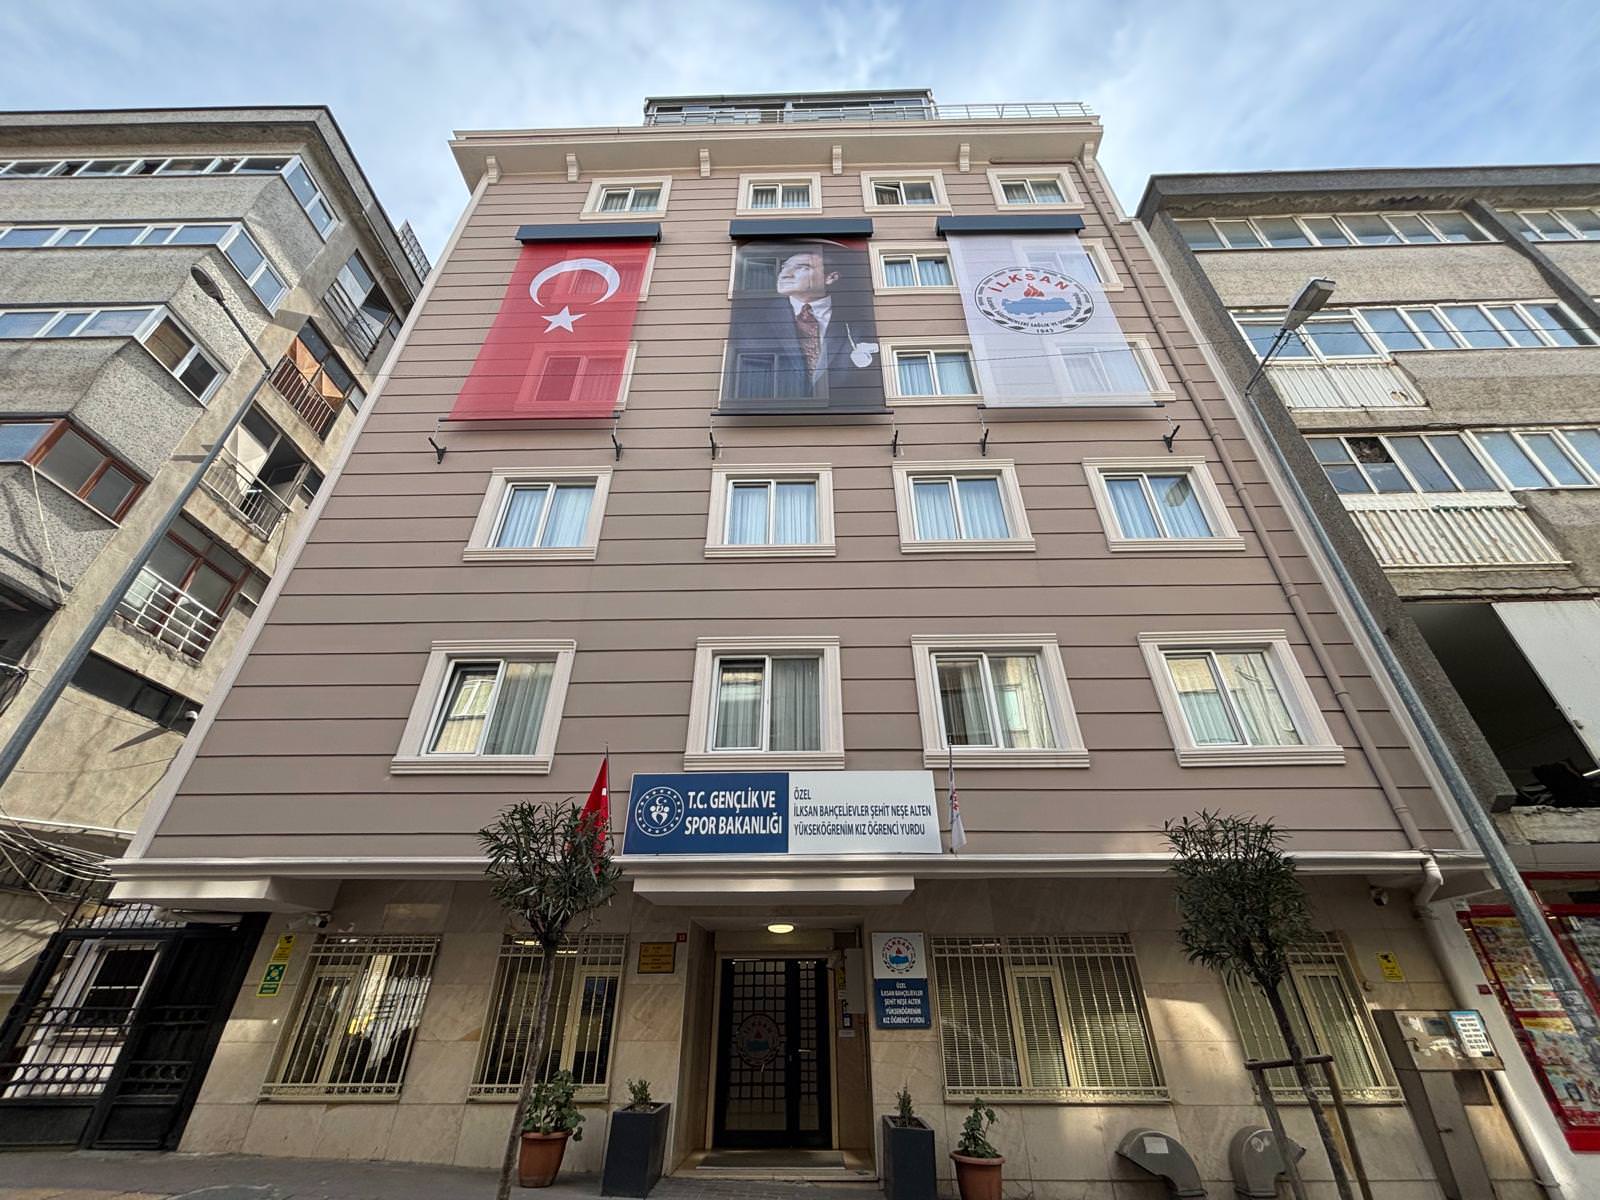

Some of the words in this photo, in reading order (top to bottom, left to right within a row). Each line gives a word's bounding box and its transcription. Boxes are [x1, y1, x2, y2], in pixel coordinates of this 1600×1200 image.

[687, 791, 708, 809] T.C.
[709, 786, 759, 814] GENÇLİK
[760, 790, 776, 808] VE
[793, 786, 811, 800] ÖZEL
[819, 803, 869, 820] BAHÇELİEVLER
[870, 802, 890, 820] ŞEHİT
[891, 804, 909, 820] NEŞE
[910, 804, 932, 817] ALTEN
[684, 816, 716, 835] SPOR
[718, 811, 783, 835] BAKANLIĞI
[794, 820, 854, 836] YÜKSEKÖĞRENİM
[855, 823, 867, 836] KIZ
[867, 820, 899, 836] ÖĞRENCİ
[900, 823, 925, 836] YURDU
